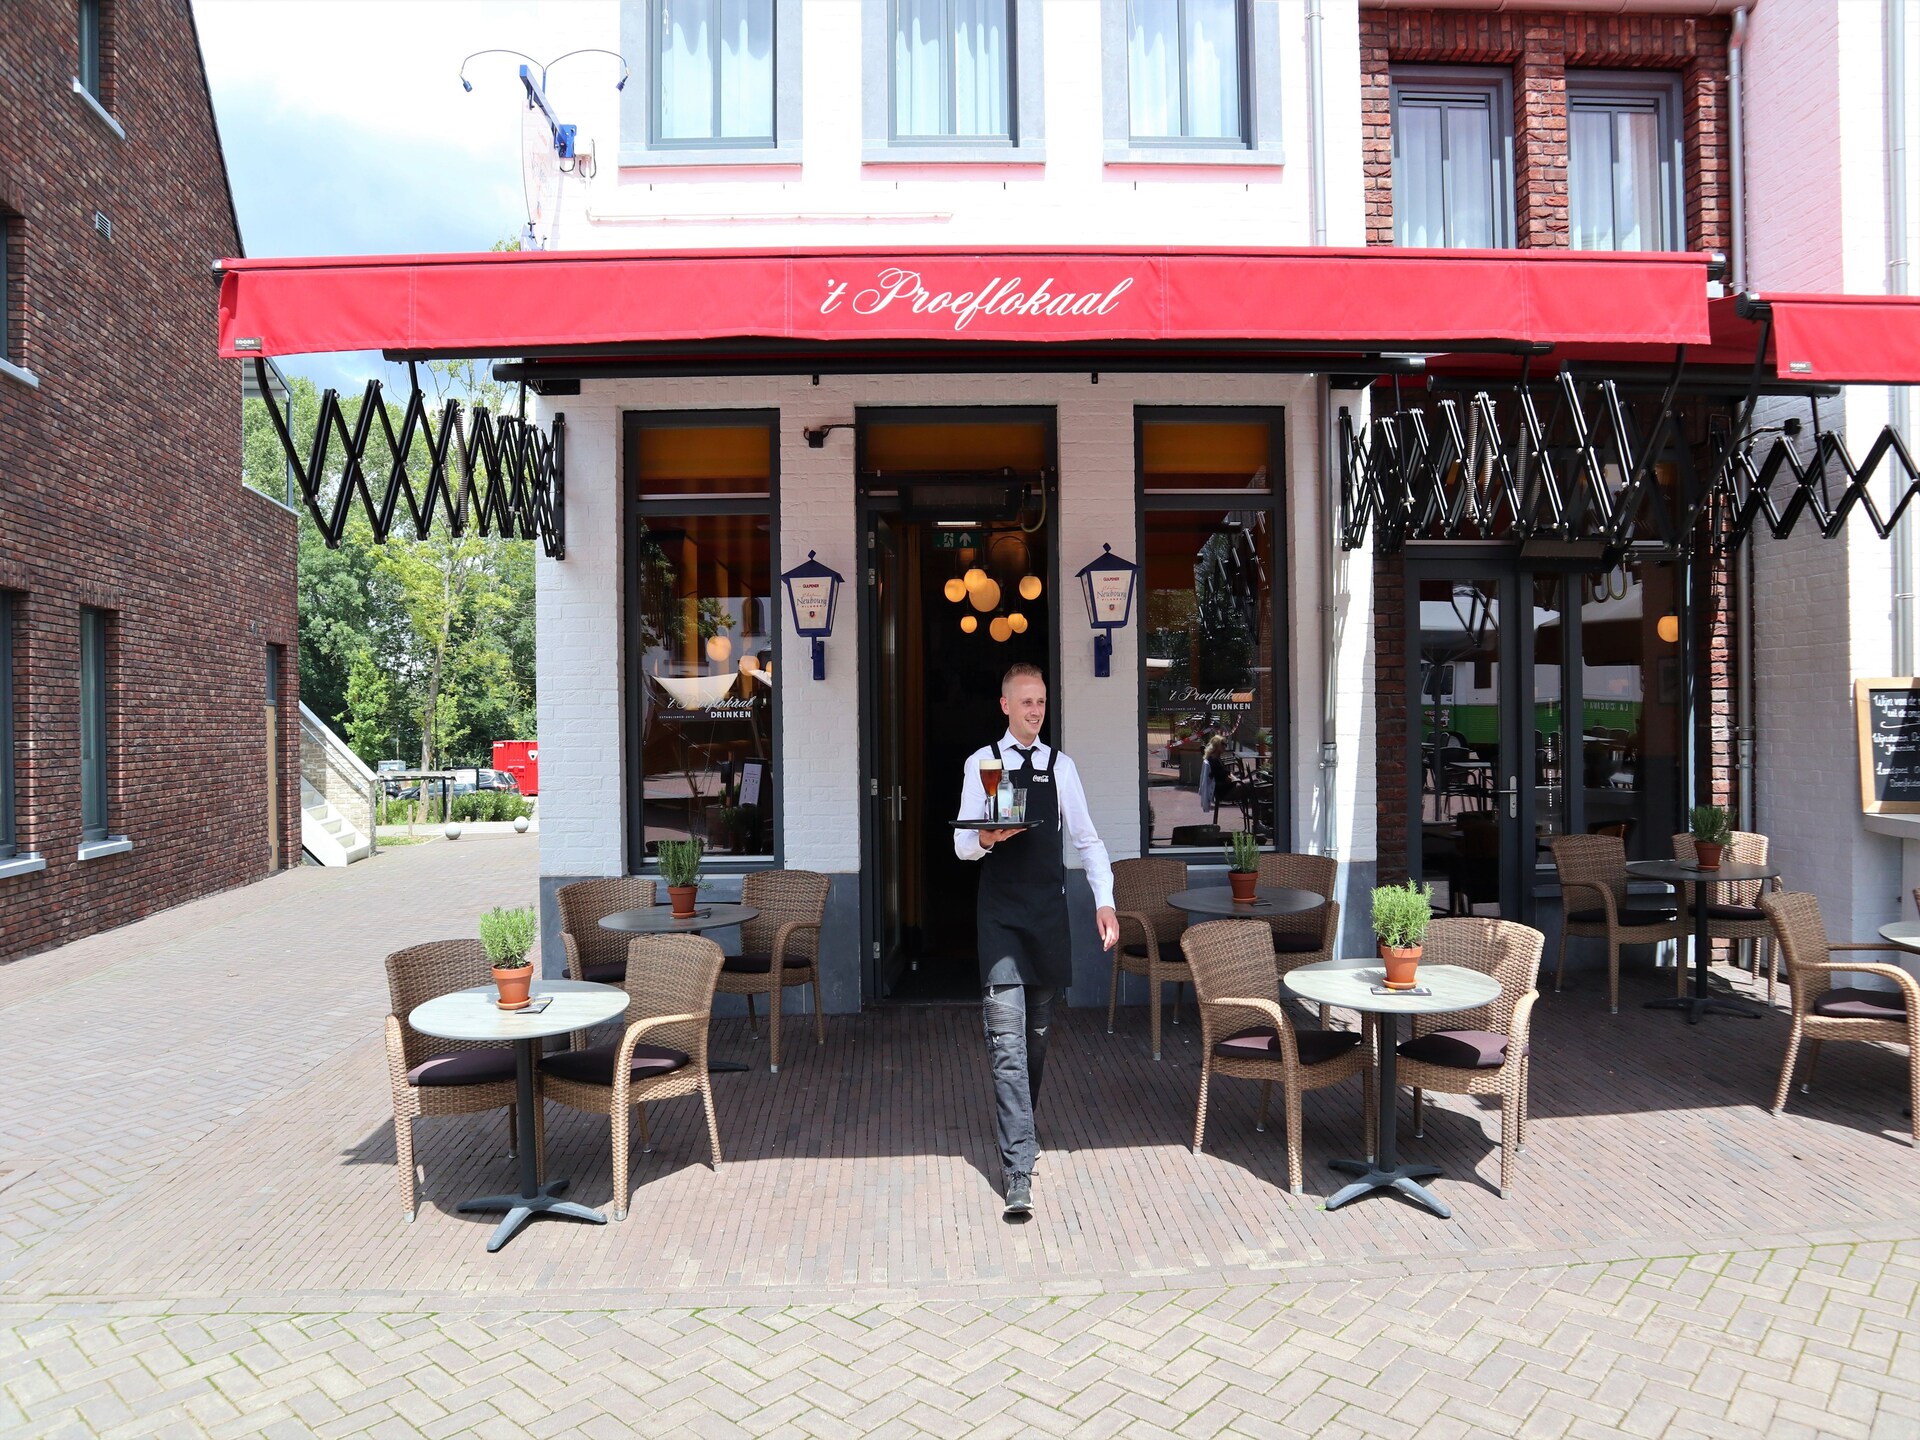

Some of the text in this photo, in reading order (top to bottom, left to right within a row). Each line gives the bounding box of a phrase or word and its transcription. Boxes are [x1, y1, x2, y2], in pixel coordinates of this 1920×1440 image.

[820, 267, 1133, 331] 't Proeflokaal
[1178, 686, 1256, 705] Proeflokaal
